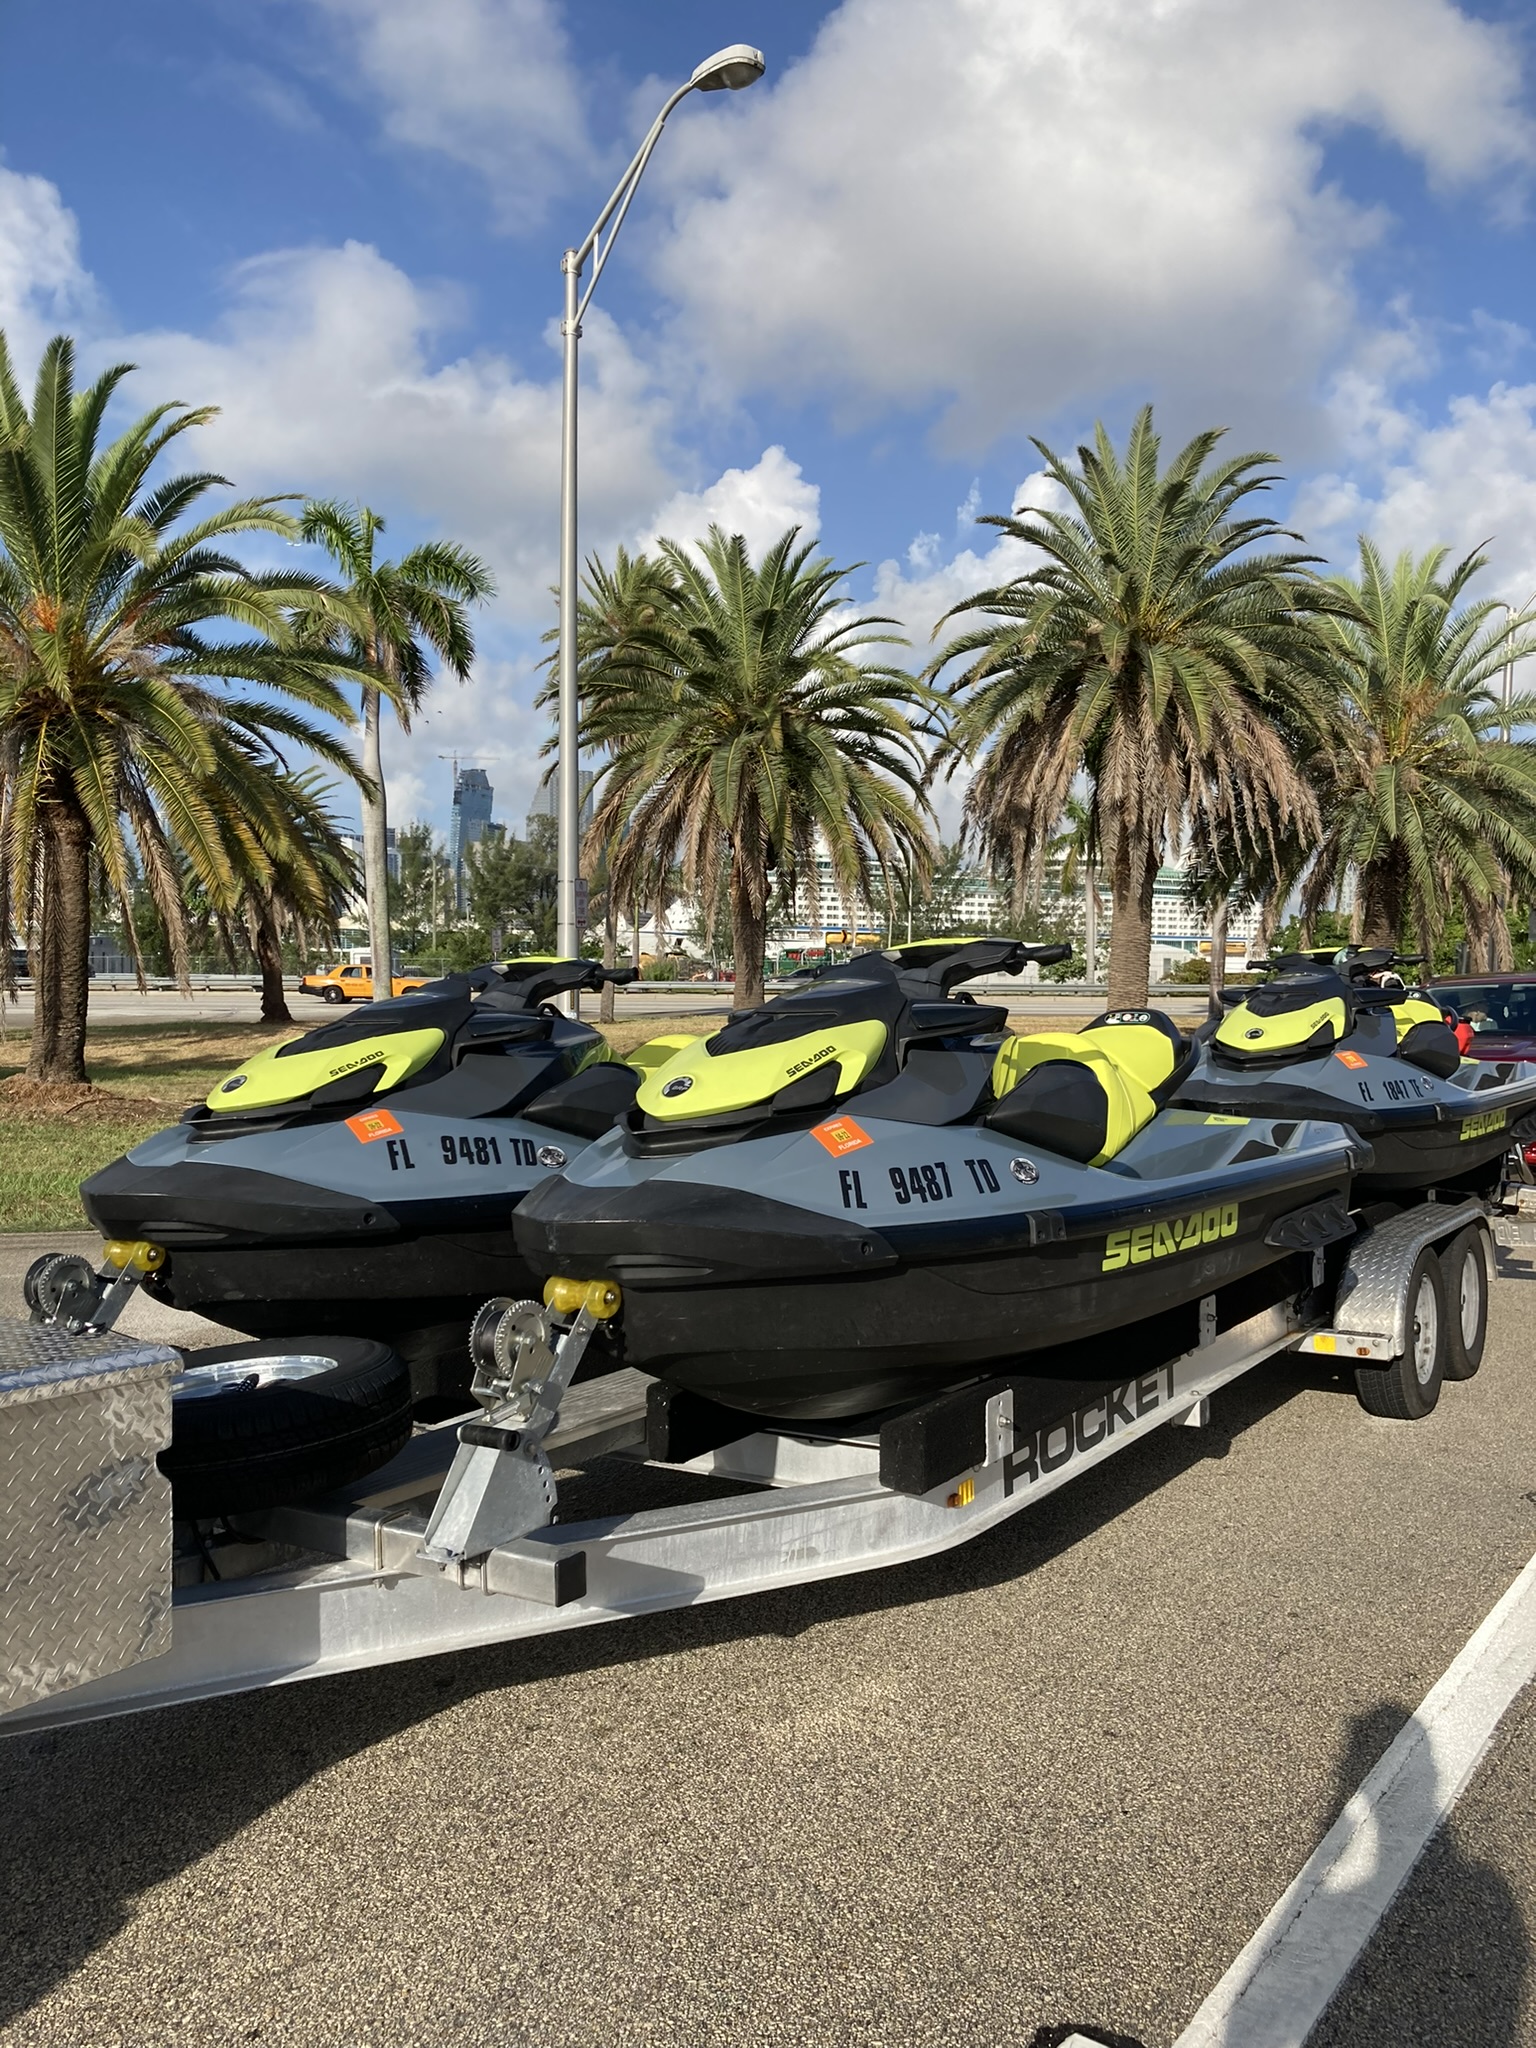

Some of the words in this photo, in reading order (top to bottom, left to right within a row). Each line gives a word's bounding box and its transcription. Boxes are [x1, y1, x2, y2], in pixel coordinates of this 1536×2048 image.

[1357, 1081, 1375, 1103] FL
[1382, 1079, 1411, 1101] 1847
[386, 1139, 415, 1171] FL
[440, 1135, 502, 1166] 9481
[509, 1137, 538, 1166] TD
[837, 1138, 863, 1151] FLORIDA
[838, 1170, 868, 1209] FL
[888, 1161, 953, 1205] 9487
[964, 1158, 1001, 1195] TD
[1002, 1355, 1182, 1499] ROCKET
